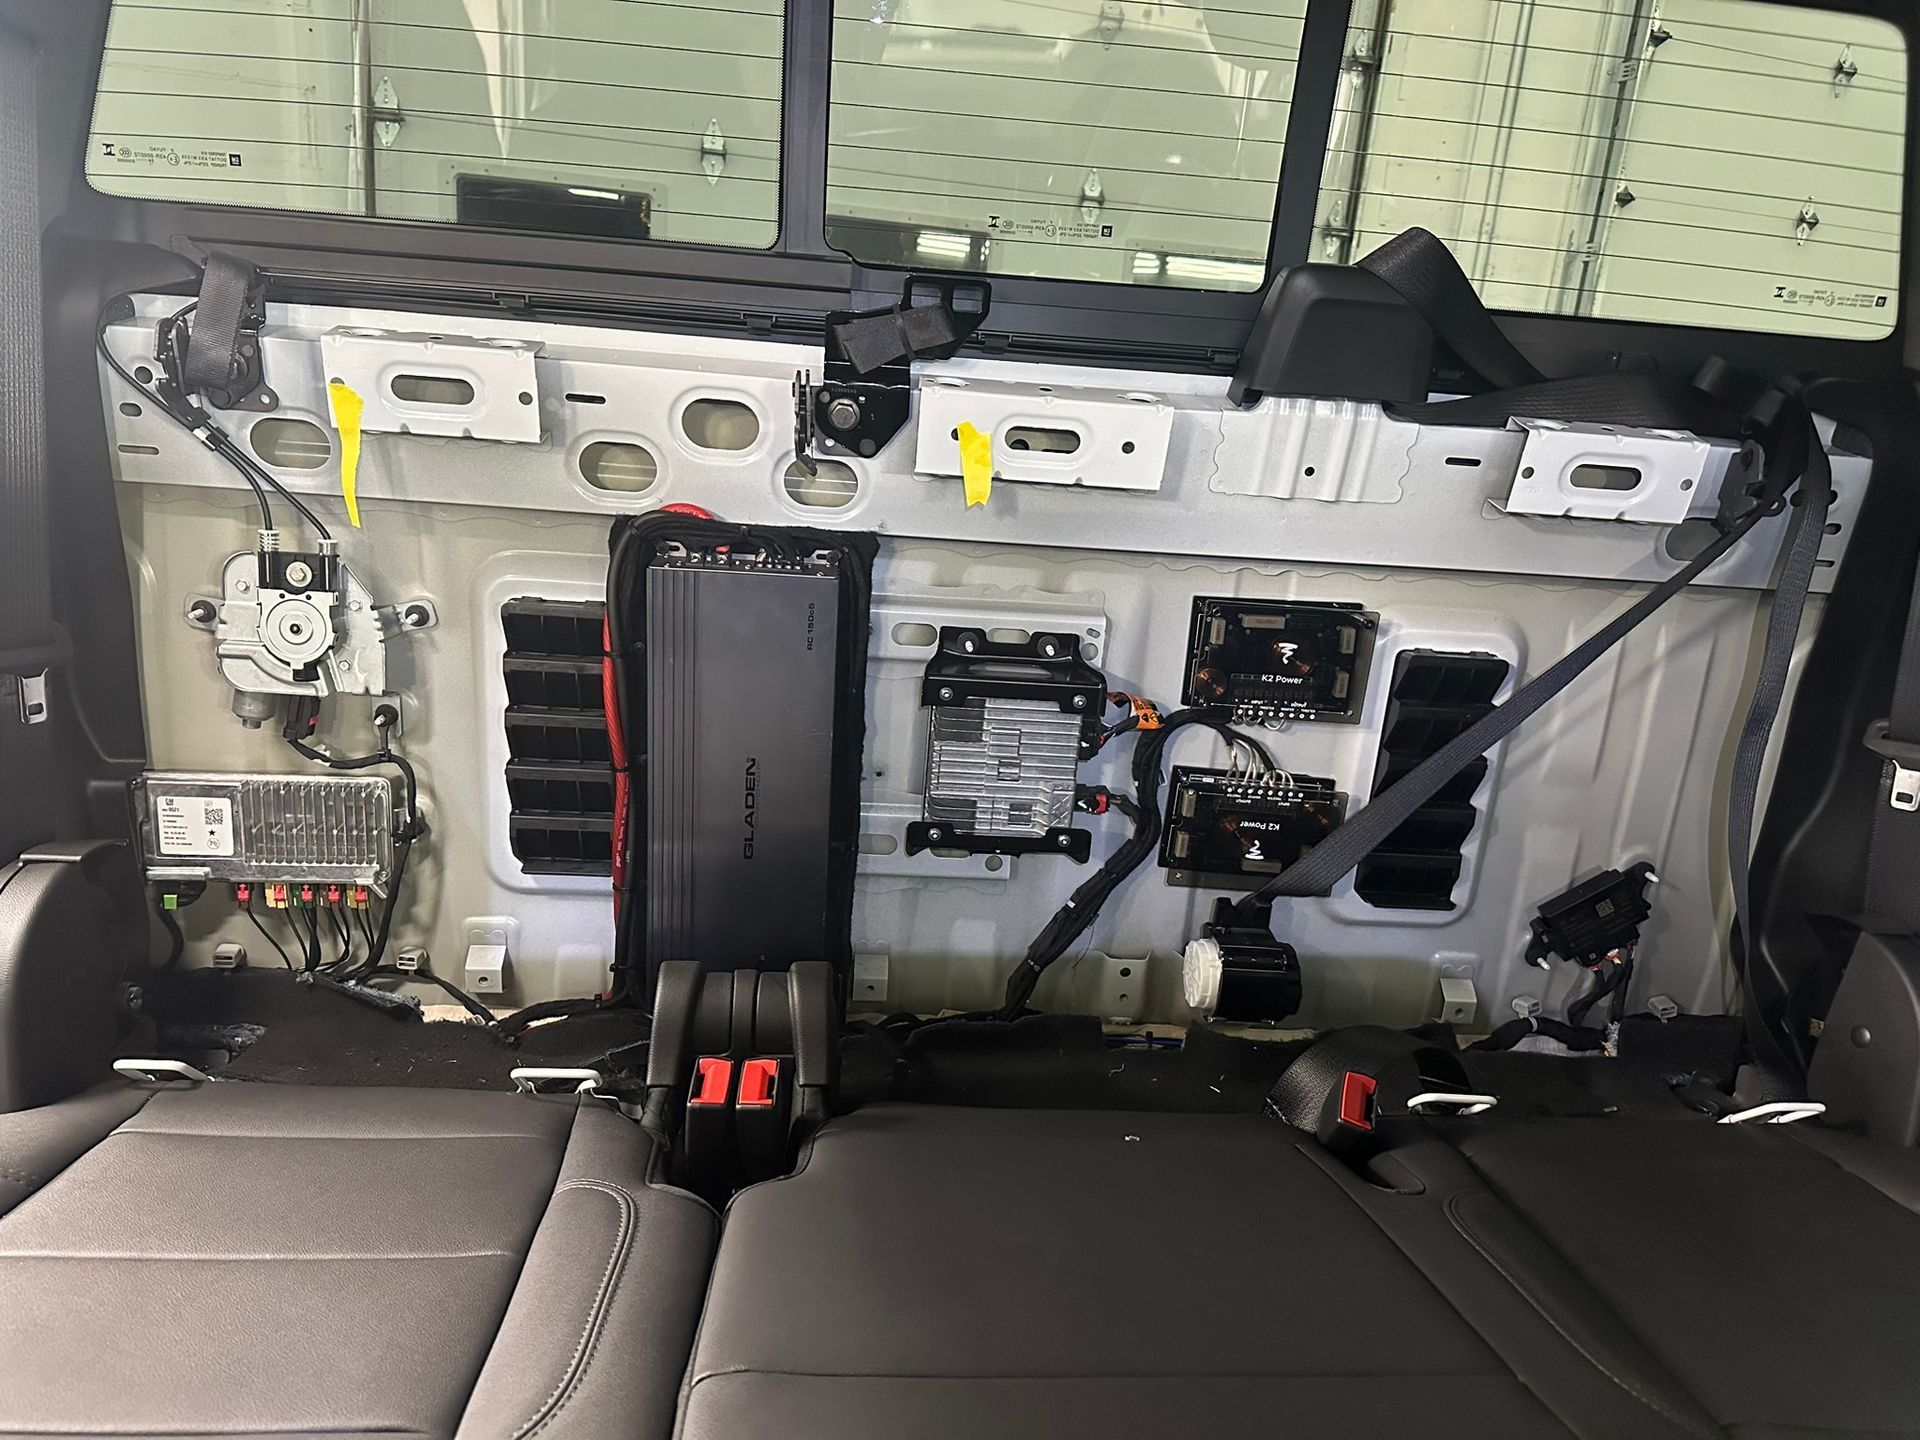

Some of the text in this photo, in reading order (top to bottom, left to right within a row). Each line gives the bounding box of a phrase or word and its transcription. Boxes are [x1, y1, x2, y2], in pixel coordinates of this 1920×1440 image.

[1261, 674, 1303, 684] K2 Power
[743, 757, 756, 860] GLADEN
[1239, 820, 1280, 831] K2 Power
